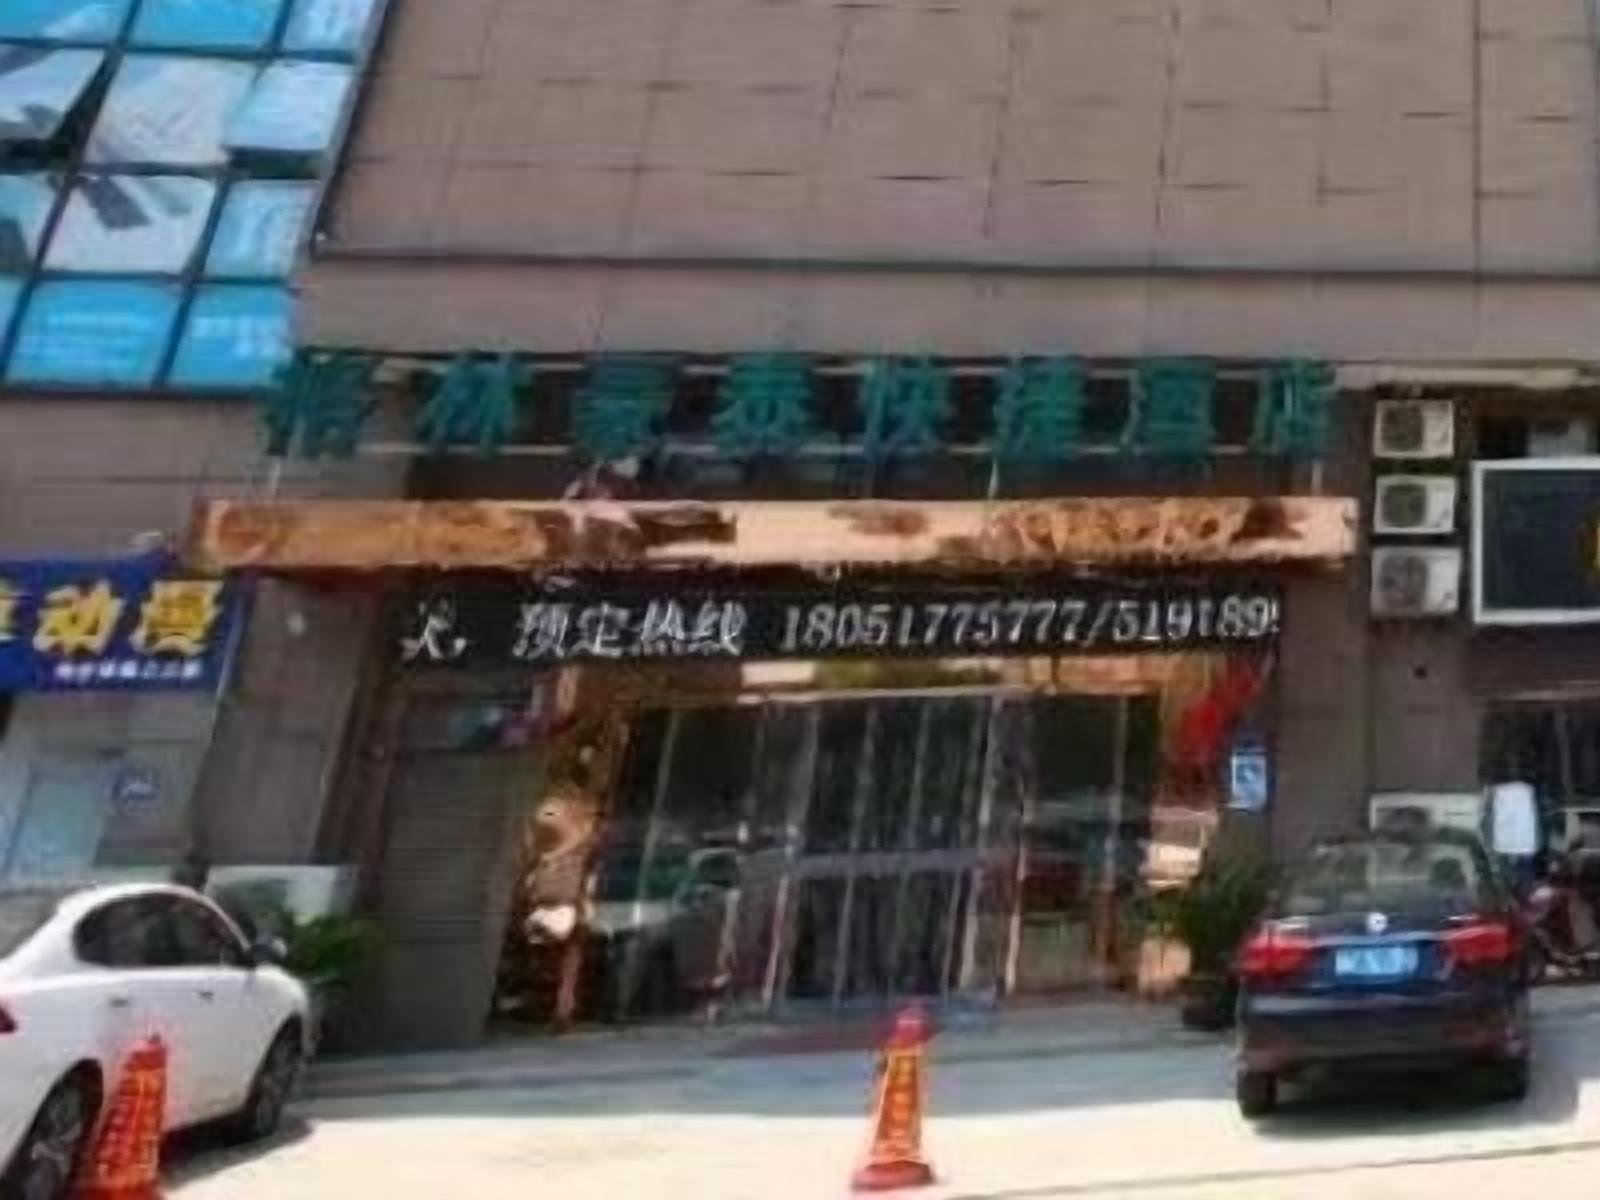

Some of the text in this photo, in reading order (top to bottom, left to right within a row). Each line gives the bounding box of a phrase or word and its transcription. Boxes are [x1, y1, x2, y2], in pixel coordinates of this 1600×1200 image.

[262, 344, 1338, 464] 格林豪泰快捷酒店
